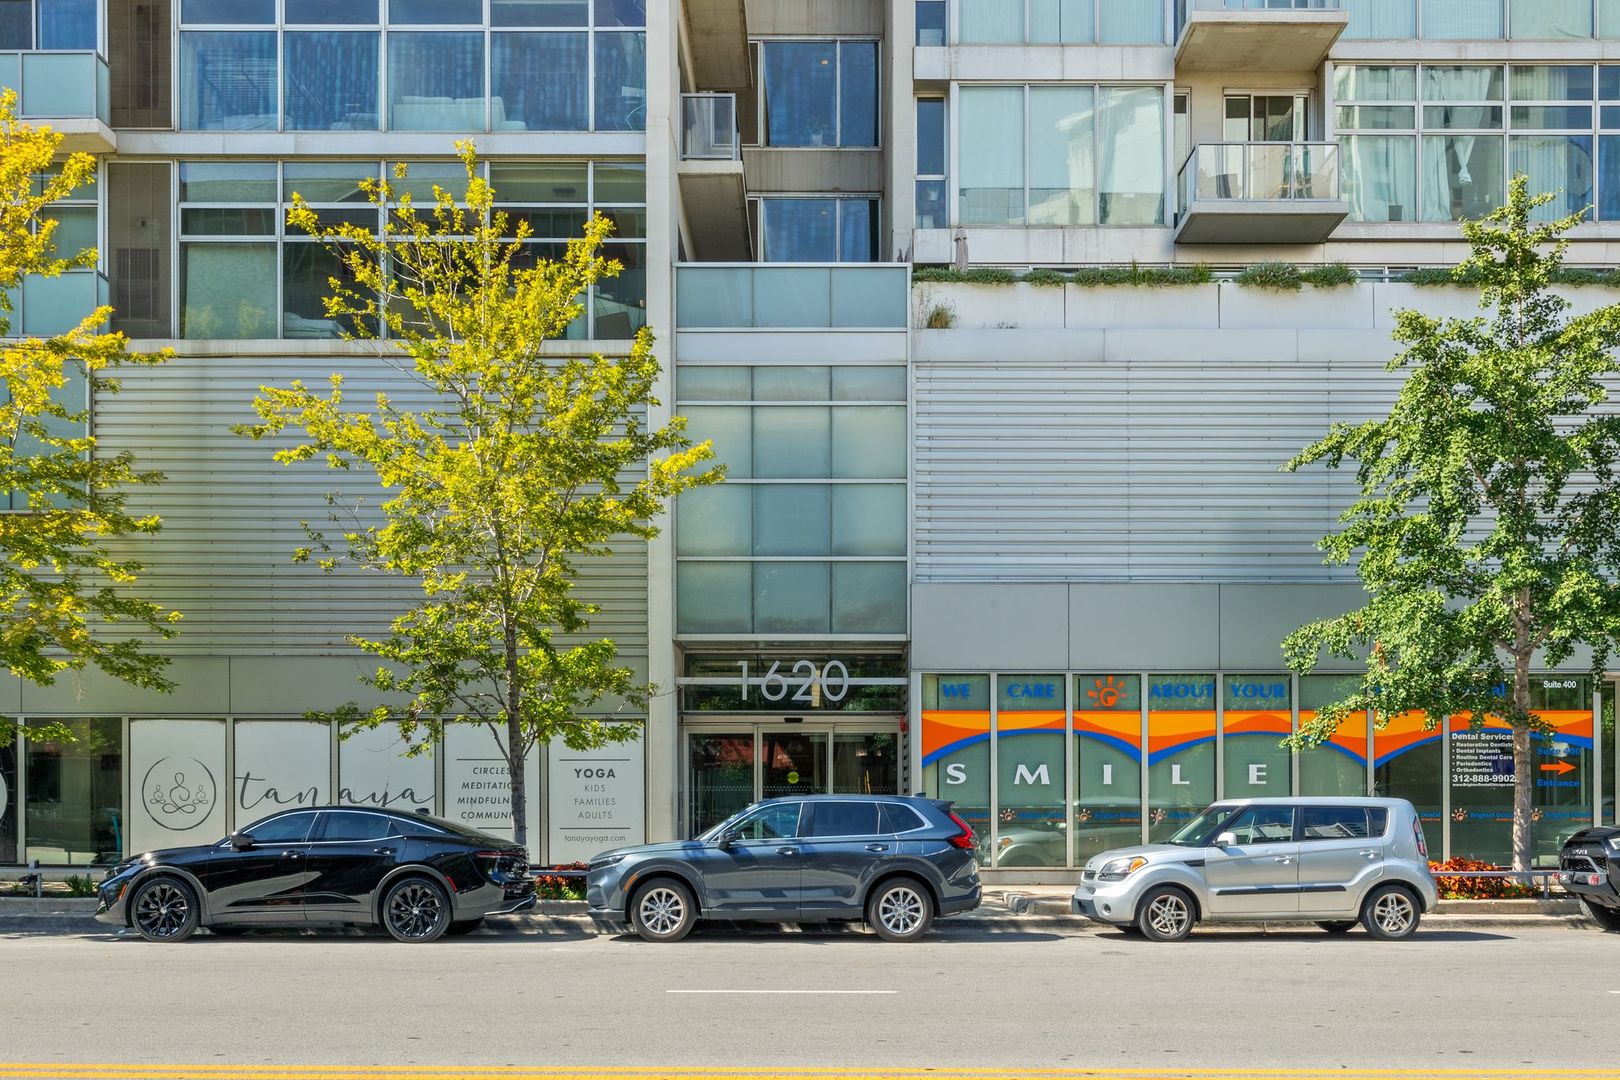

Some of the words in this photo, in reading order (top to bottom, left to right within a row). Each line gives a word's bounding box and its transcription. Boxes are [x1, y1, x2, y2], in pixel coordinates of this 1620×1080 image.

[737, 660, 849, 701] 1620
[942, 683, 970, 698] WE
[1007, 683, 1055, 698] CARE
[1150, 683, 1215, 698] ABOUT
[1231, 684, 1285, 698] YOUR
[1536, 747, 1560, 755] Suite
[1563, 747, 1581, 755] 400
[472, 767, 511, 775] CIRCLES
[574, 768, 616, 778] YOGA
[1452, 774, 1515, 782] 312-888-9902
[1536, 779, 1580, 787] Entrance
[235, 771, 435, 809] tanaya
[584, 784, 606, 792] KIDS
[578, 811, 613, 819] ADULTS
